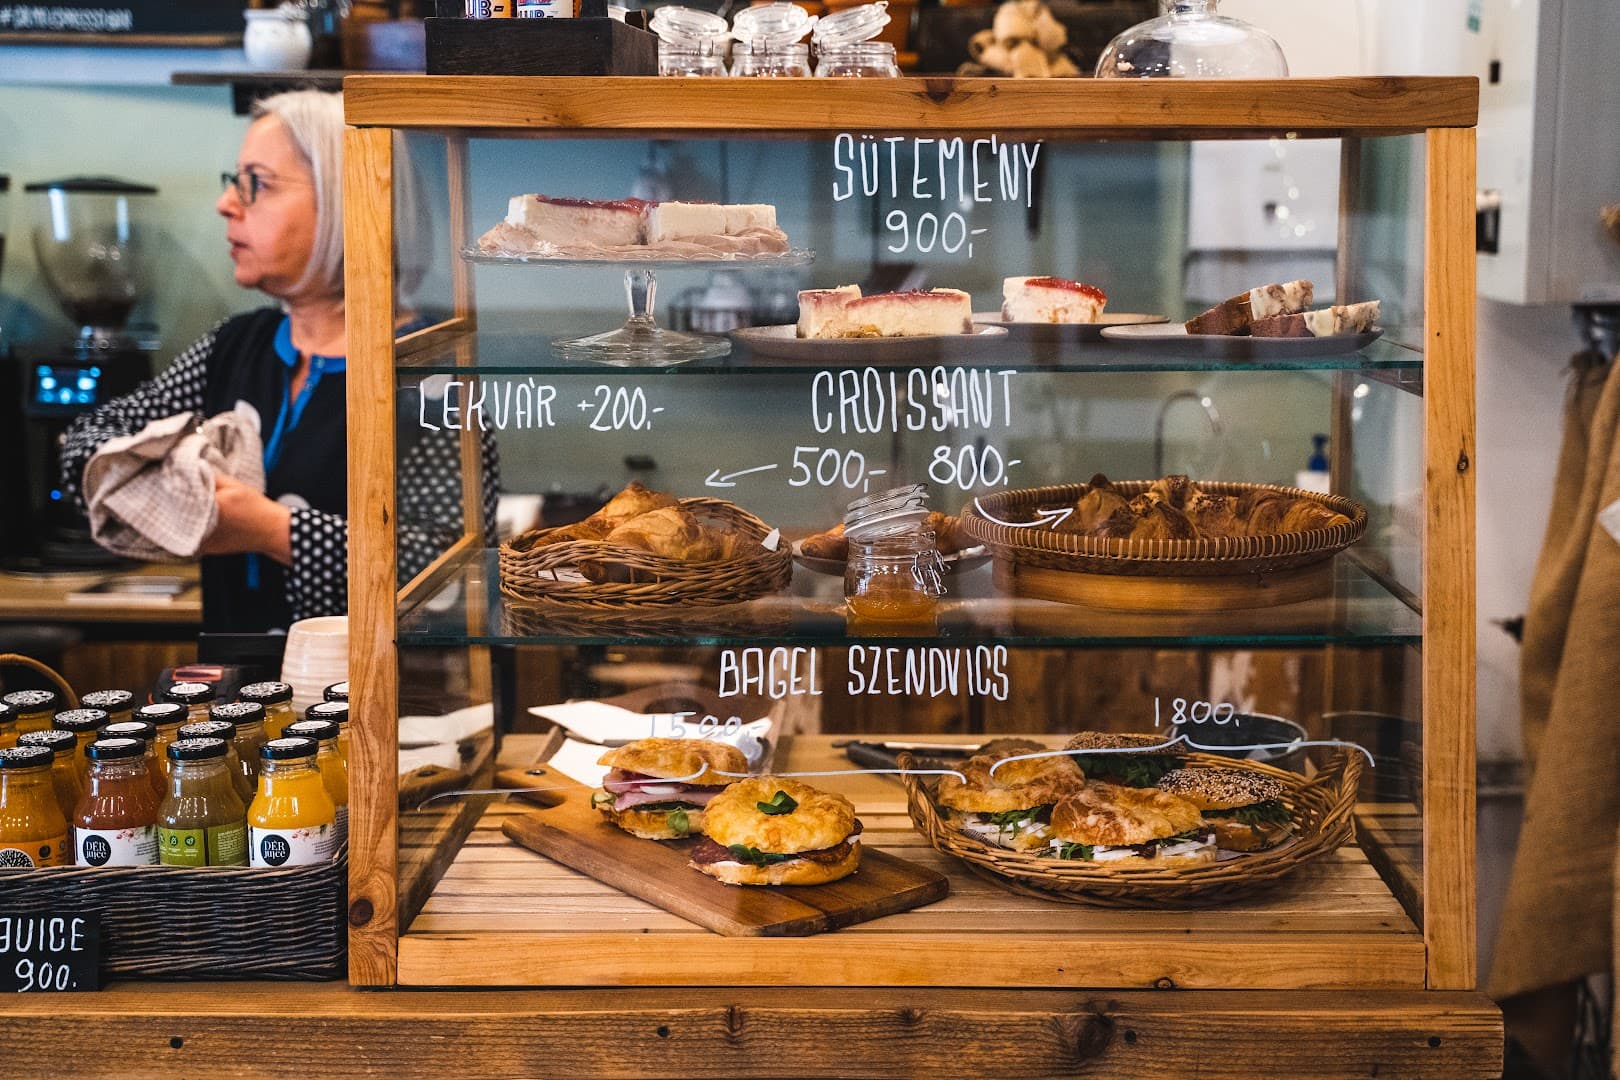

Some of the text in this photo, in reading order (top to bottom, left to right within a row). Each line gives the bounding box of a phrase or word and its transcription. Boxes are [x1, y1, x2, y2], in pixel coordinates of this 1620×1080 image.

[419, 377, 557, 431] LEKVÁR
[811, 366, 1018, 434] CROISSANT
[718, 644, 1009, 701] BAGEL SZENDVICS
